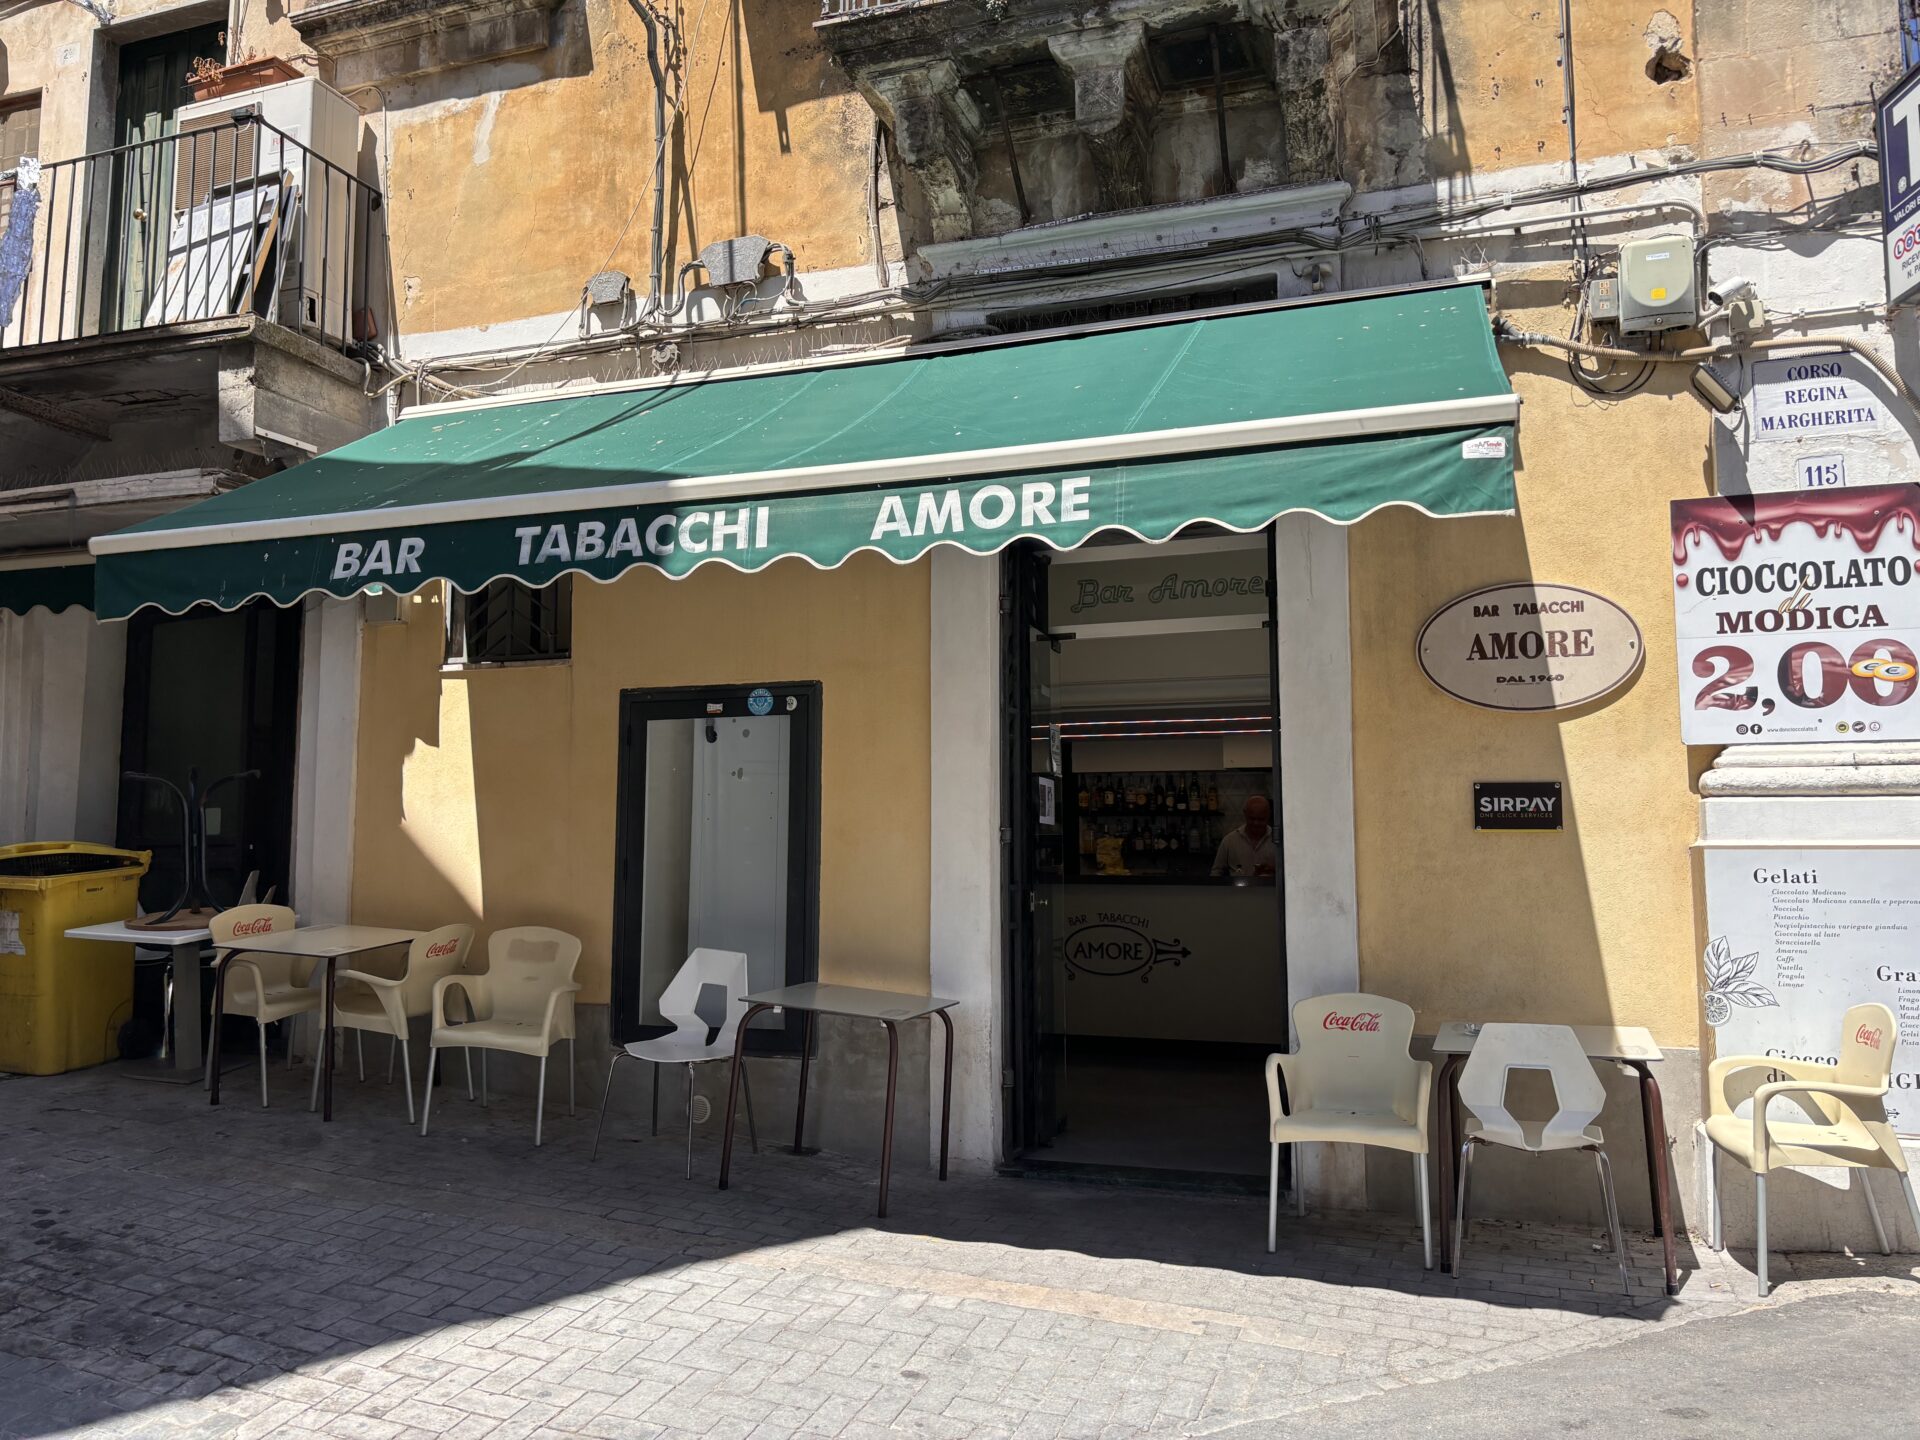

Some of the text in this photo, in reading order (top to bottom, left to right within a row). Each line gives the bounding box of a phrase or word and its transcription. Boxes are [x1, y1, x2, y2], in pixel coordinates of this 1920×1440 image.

[1893, 199, 1916, 222] VALORI
[1787, 362, 1842, 381] CORSO
[1785, 386, 1848, 404] REGINA
[1761, 407, 1876, 432] MARGHERITA
[1804, 464, 1838, 487] 115
[332, 476, 1091, 580] BAR TABACCHI AMORE
[1695, 555, 1912, 597] CIOCCOLATO
[1070, 573, 1265, 613] Bar Amore
[1778, 574, 1814, 615] di
[1473, 600, 1584, 618] BAR TABACCHI
[1715, 604, 1888, 635] MODICA
[1466, 628, 1595, 661] AMORE
[1496, 674, 1564, 683] DAL 1960
[1692, 638, 1919, 717] 2,00
[1480, 797, 1556, 812] SIRPAY
[1753, 868, 1818, 884] Gelati
[1068, 912, 1150, 929] BAR TABACCHI
[1773, 913, 1810, 921] Pistacchio
[1814, 930, 1822, 938] al
[1824, 930, 1841, 938] latte
[1838, 923, 1873, 932] variegato
[1073, 941, 1144, 960] AMORE
[1774, 938, 1821, 946] Stracciatella
[1776, 963, 1803, 971] Nutella
[1777, 972, 1805, 980] Fragola
[1876, 965, 1920, 982] Gra
[1777, 980, 1805, 988] Limone
